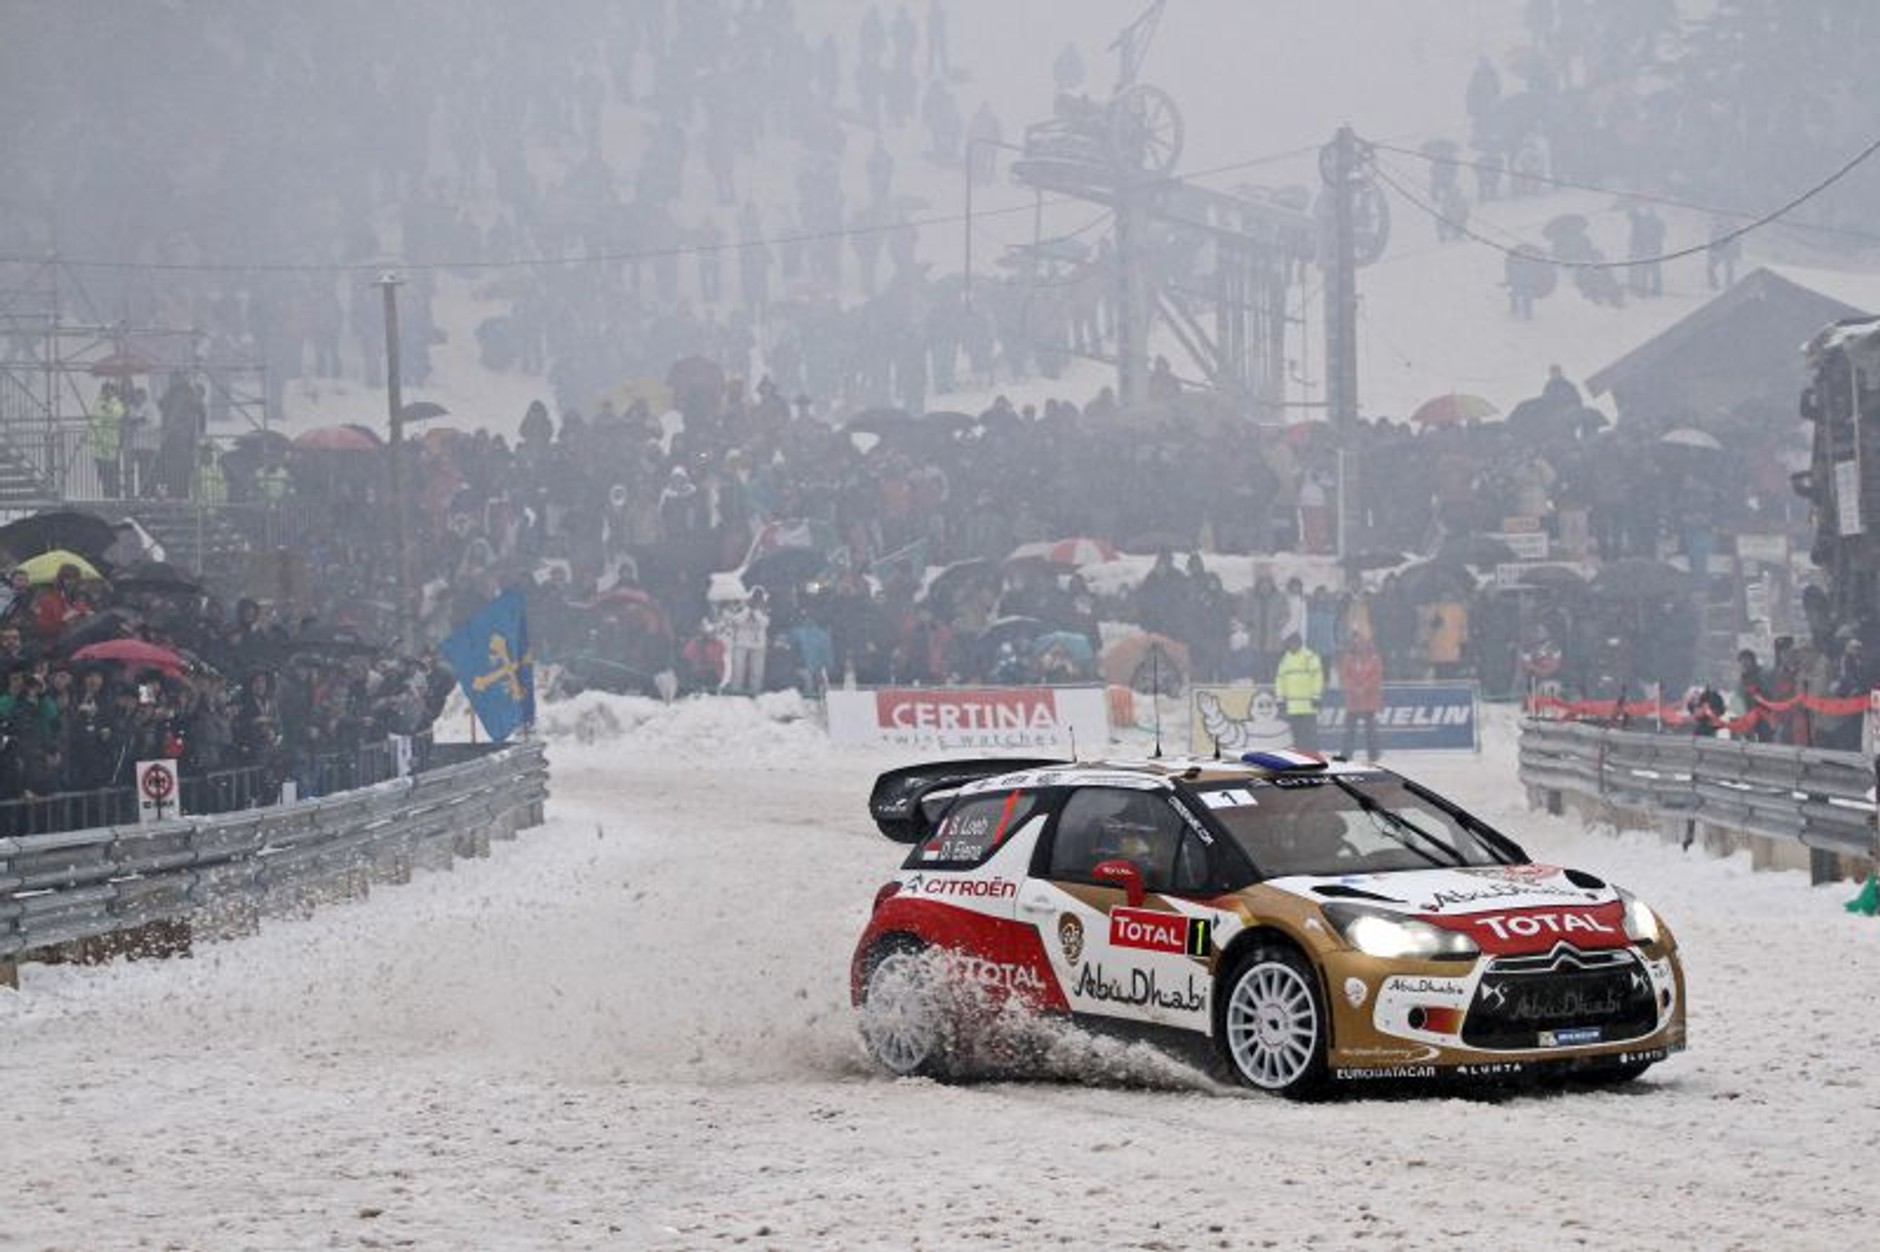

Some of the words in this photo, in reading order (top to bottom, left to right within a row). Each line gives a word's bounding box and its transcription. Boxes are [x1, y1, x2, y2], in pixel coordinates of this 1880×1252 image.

[891, 702, 1055, 729] CERTINA
[1316, 705, 1470, 724] MIHELIN
[960, 732, 1058, 746] watches
[925, 877, 1016, 897] CITROËN
[1114, 916, 1183, 946] TOTAL
[1195, 920, 1204, 955] 1
[1475, 913, 1615, 940] TOTAL
[963, 956, 1047, 989] TOTAL
